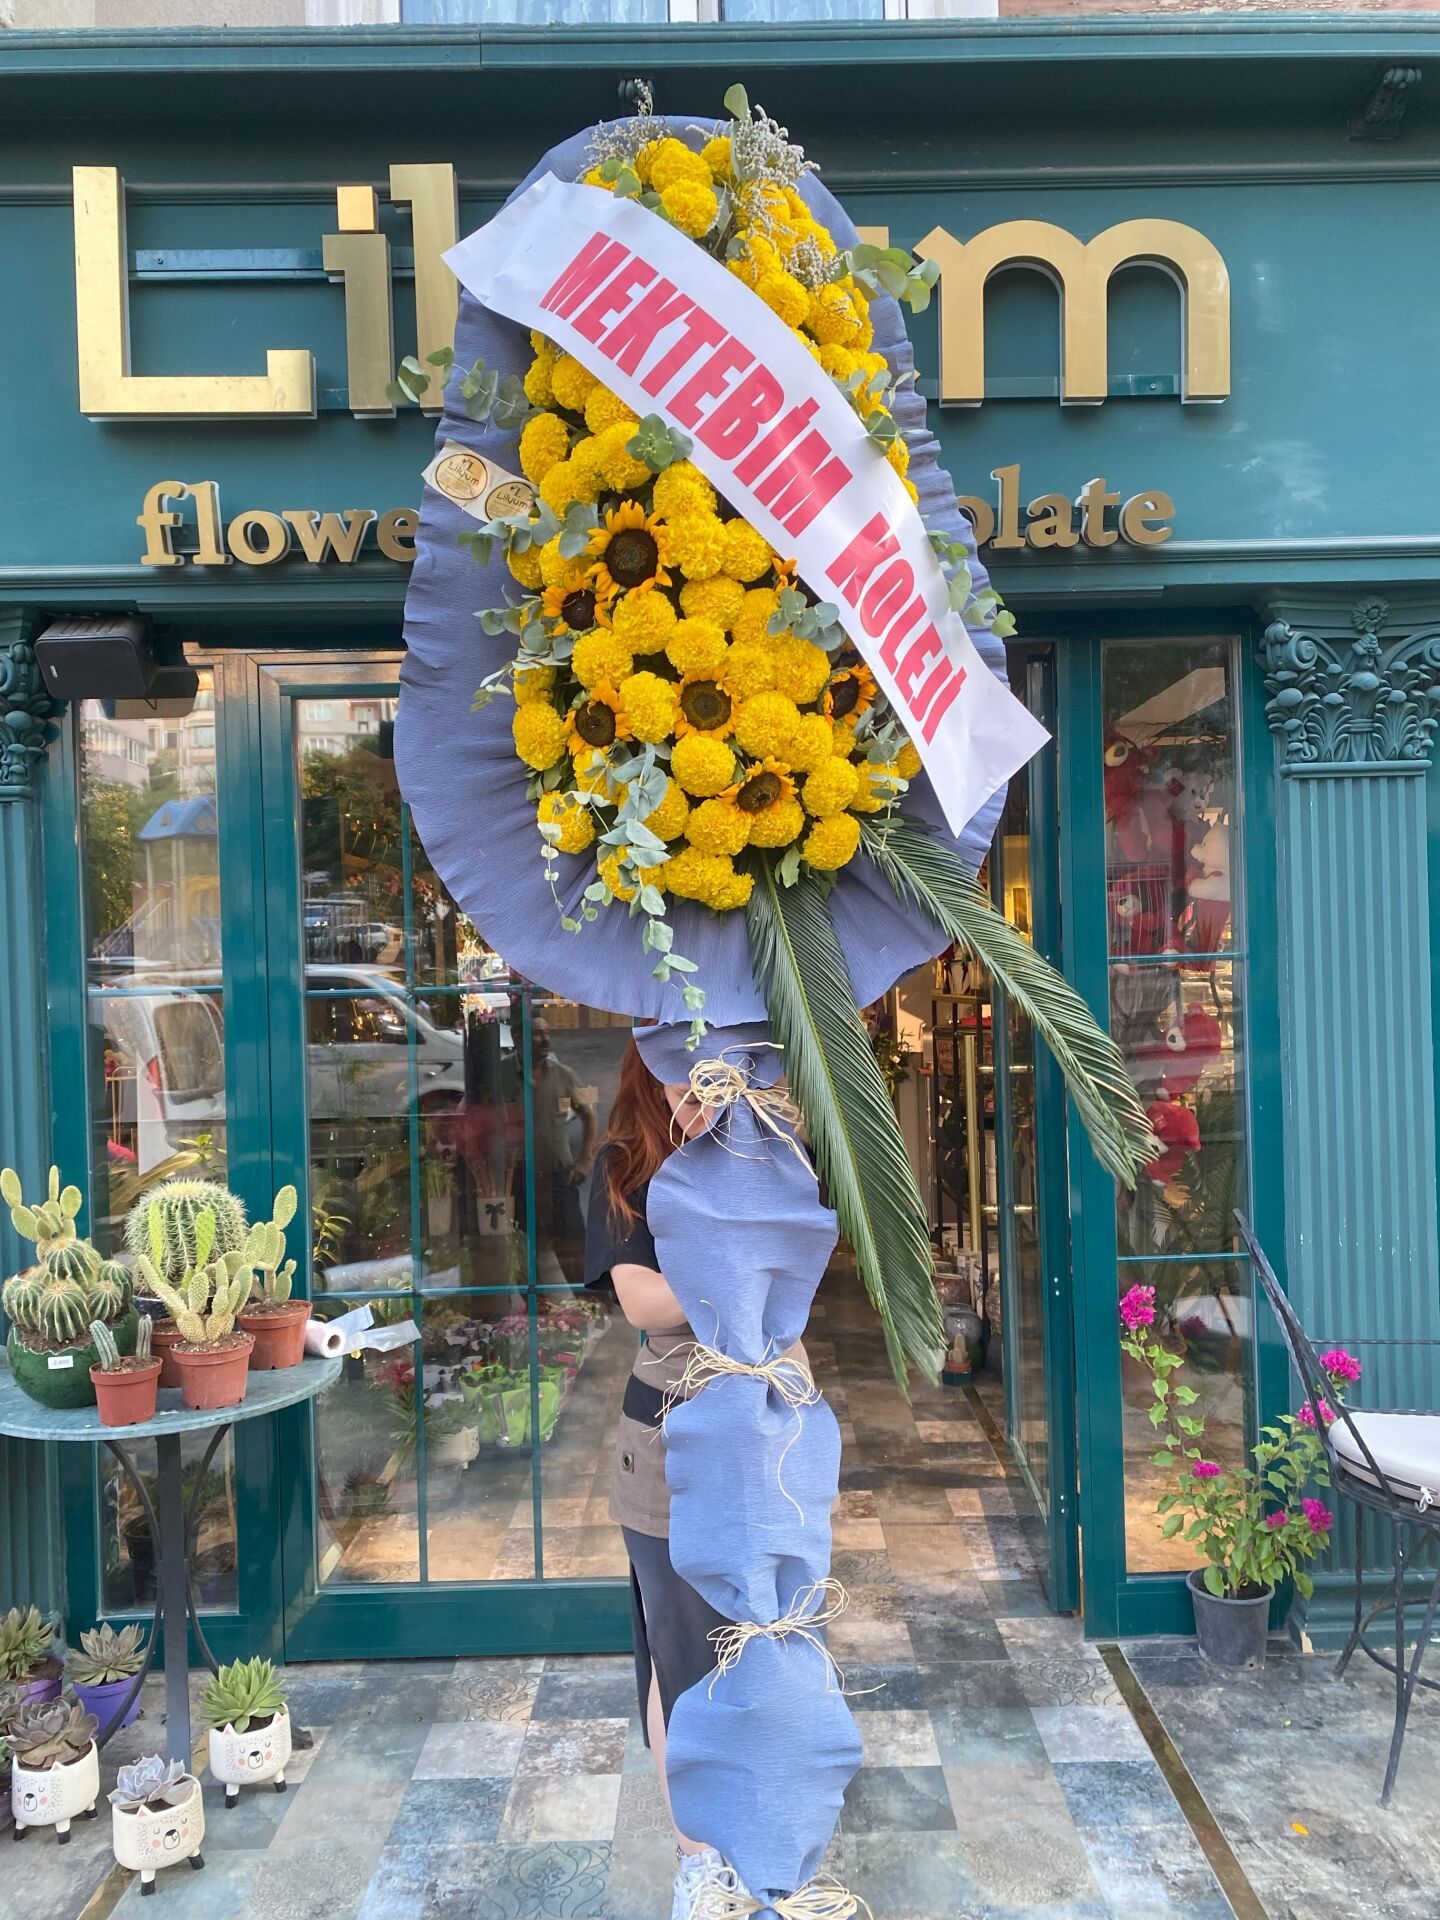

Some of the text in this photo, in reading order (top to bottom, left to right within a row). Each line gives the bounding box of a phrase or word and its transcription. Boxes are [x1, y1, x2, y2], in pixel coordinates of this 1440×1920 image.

[73, 162, 1231, 417] Lilm
[448, 461, 479, 486] Lilyum
[496, 491, 528, 509] Lilyum
[540, 231, 967, 745] MEKTEBİM KOLEJİ
[137, 480, 418, 565] flowe
